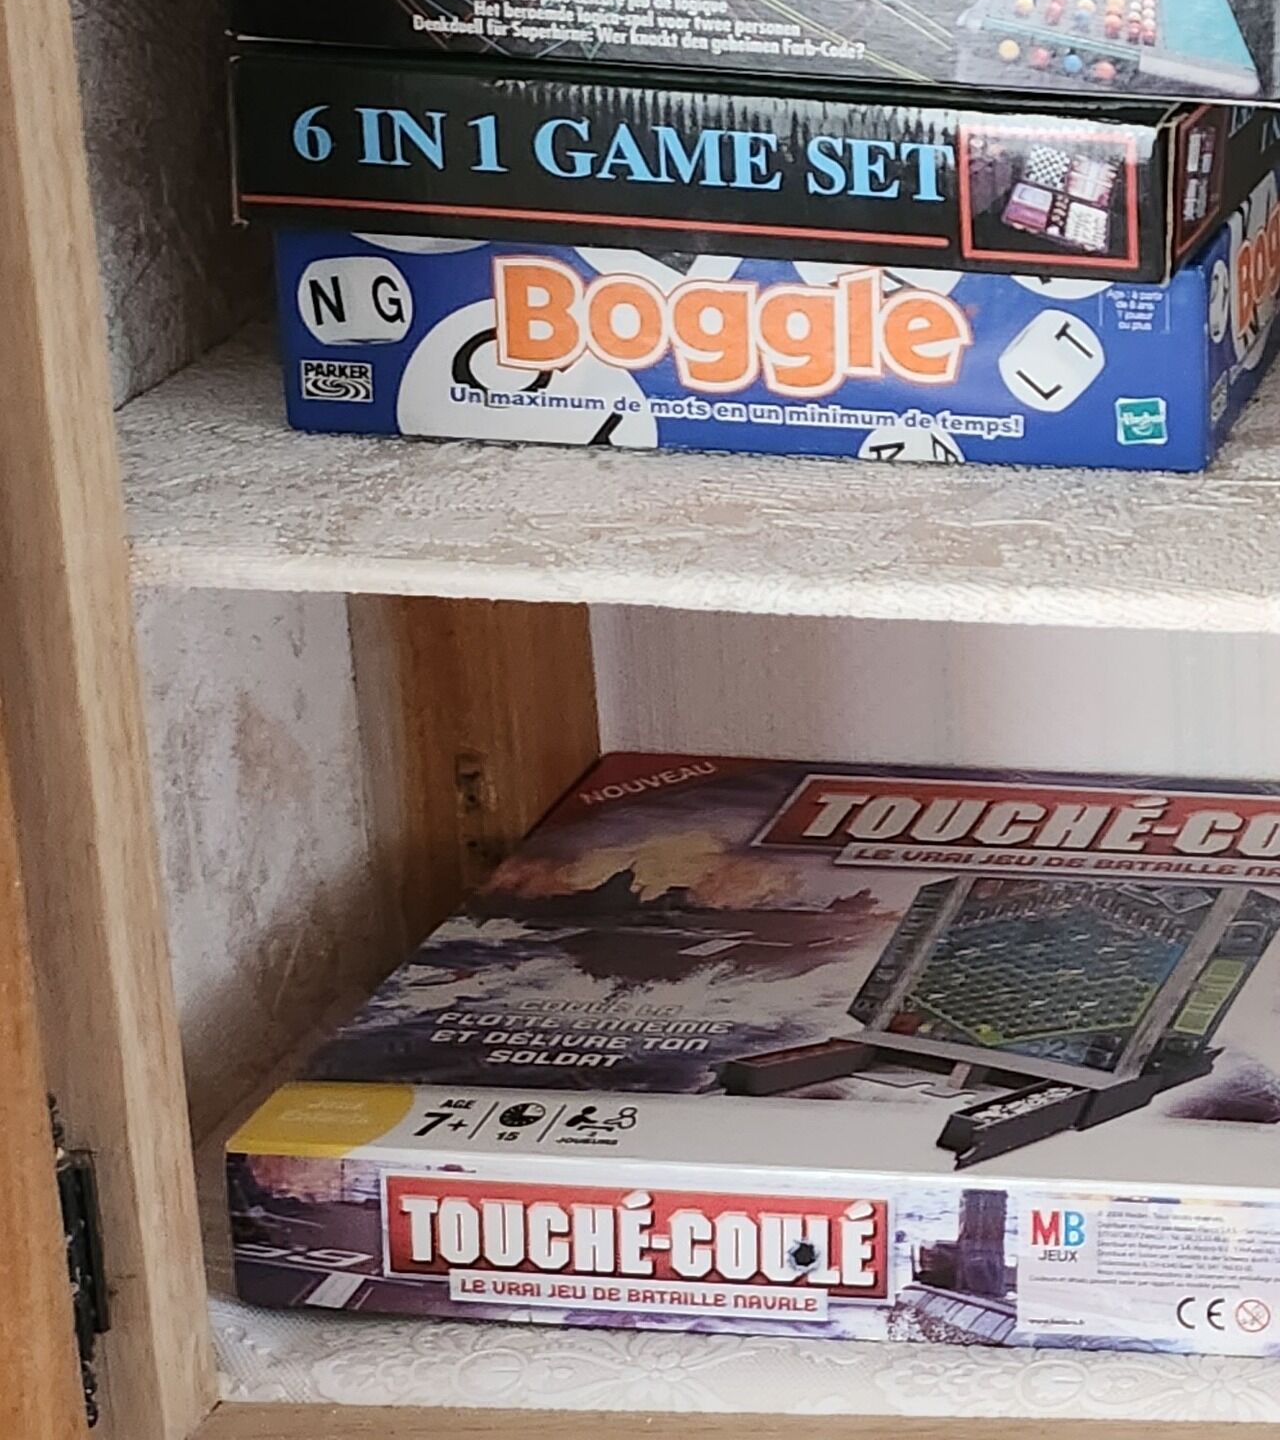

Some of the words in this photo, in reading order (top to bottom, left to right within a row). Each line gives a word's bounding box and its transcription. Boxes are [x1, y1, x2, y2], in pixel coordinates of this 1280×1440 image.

[474, 0, 499, 17] Het
[657, 13, 690, 29] voor
[597, 24, 628, 44] Wer
[680, 30, 708, 48] den
[292, 105, 335, 162] 6
[354, 106, 447, 171] IN
[467, 114, 509, 174] 1
[533, 117, 783, 192] GAME
[805, 136, 955, 203] SET
[493, 254, 973, 399] Boggle
[303, 362, 370, 381] PARKER
[449, 386, 482, 406] Un
[488, 389, 606, 412] maximum
[613, 395, 643, 414] de
[650, 399, 709, 420] mots
[717, 404, 746, 421] en
[752, 407, 782, 423] un
[788, 406, 897, 429] minimum
[904, 412, 934, 430] de
[941, 414, 1024, 438] temps!
[578, 760, 718, 807] NOUVEAU
[435, 1011, 569, 1031] FLOTTE
[430, 1030, 479, 1044] ET
[485, 1049, 627, 1068] SOLDAT
[439, 1099, 477, 1110] AGE
[411, 1111, 469, 1138] 7+
[400, 1190, 881, 1288] TOUCHÉ-COULÉ
[1029, 1209, 1086, 1248] MB
[1037, 1248, 1079, 1263] JEUX
[460, 1278, 486, 1297] LE
[491, 1280, 543, 1300] VRAI
[546, 1284, 587, 1302] JEU
[591, 1286, 623, 1303] DE
[626, 1288, 729, 1309] BATAILLE
[732, 1292, 820, 1313] NAVALE
